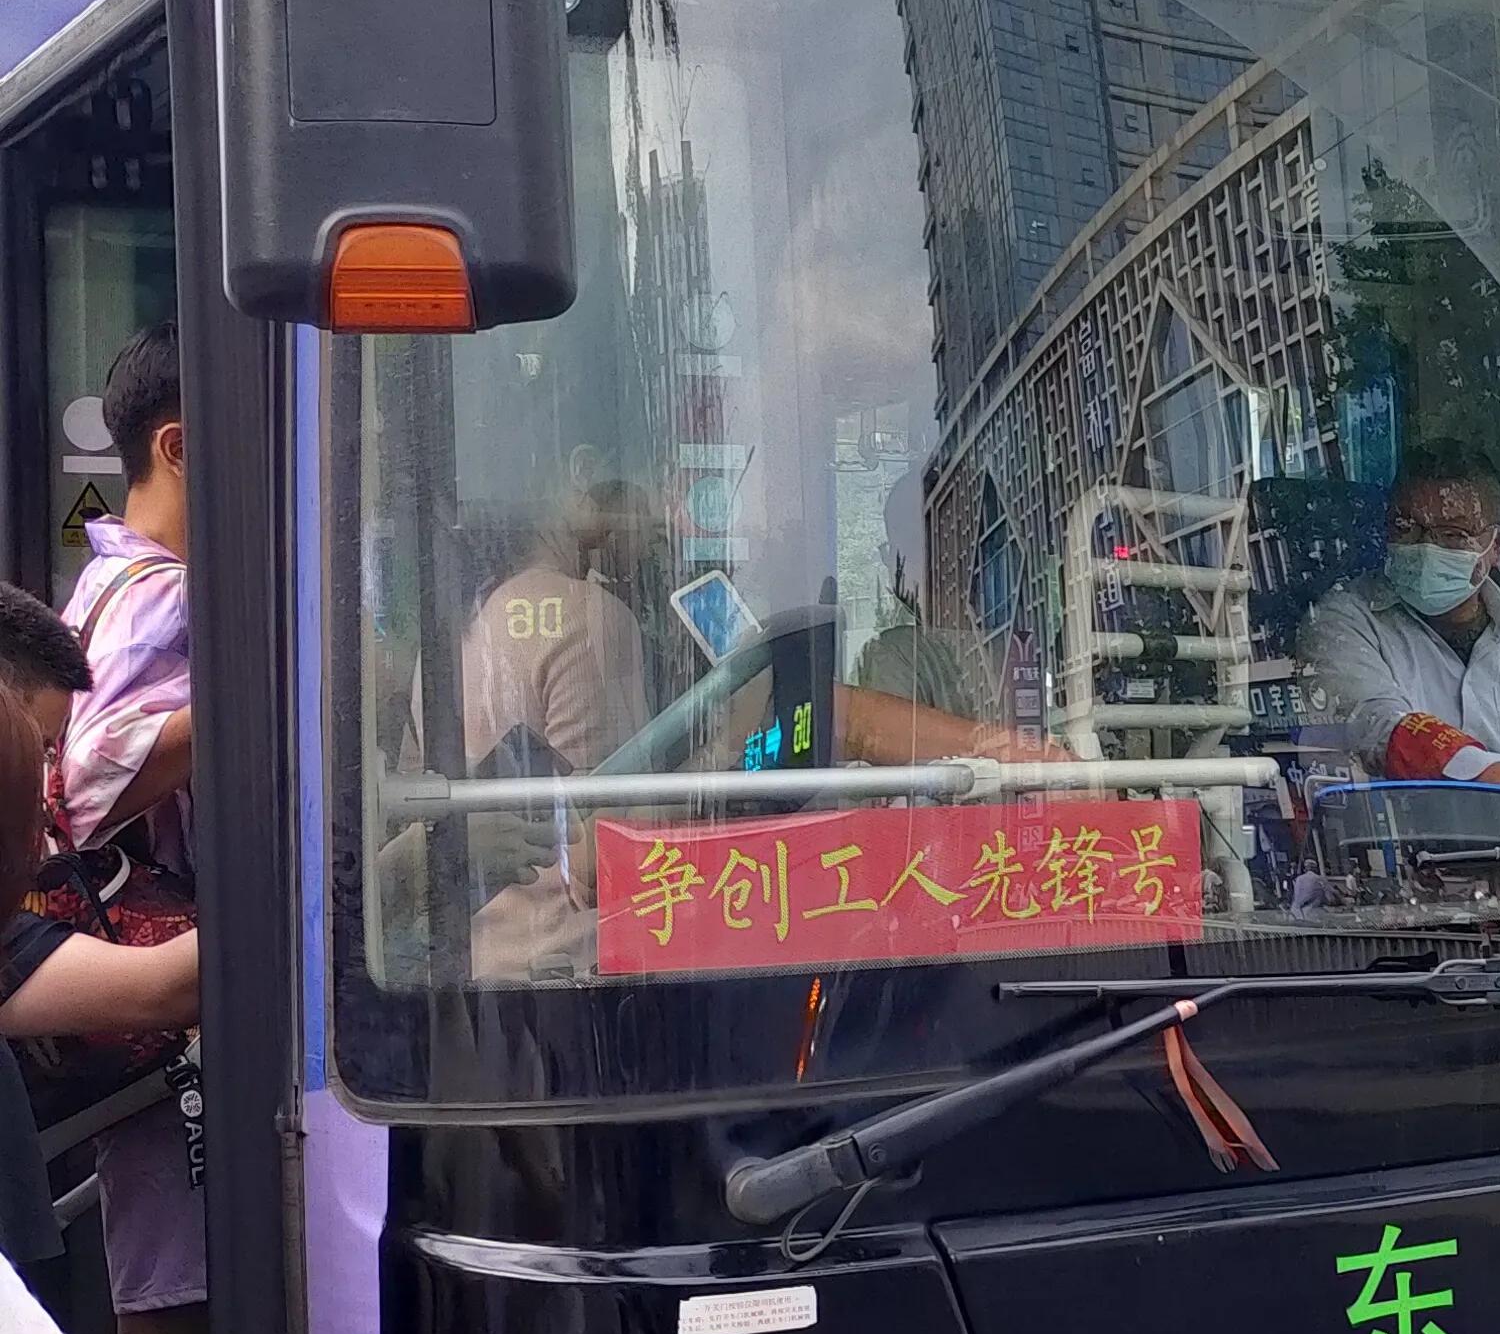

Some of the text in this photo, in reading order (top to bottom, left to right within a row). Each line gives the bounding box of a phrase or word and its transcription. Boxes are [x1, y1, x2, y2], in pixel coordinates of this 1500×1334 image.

[630, 825, 1178, 947] 争创工人先锋号
